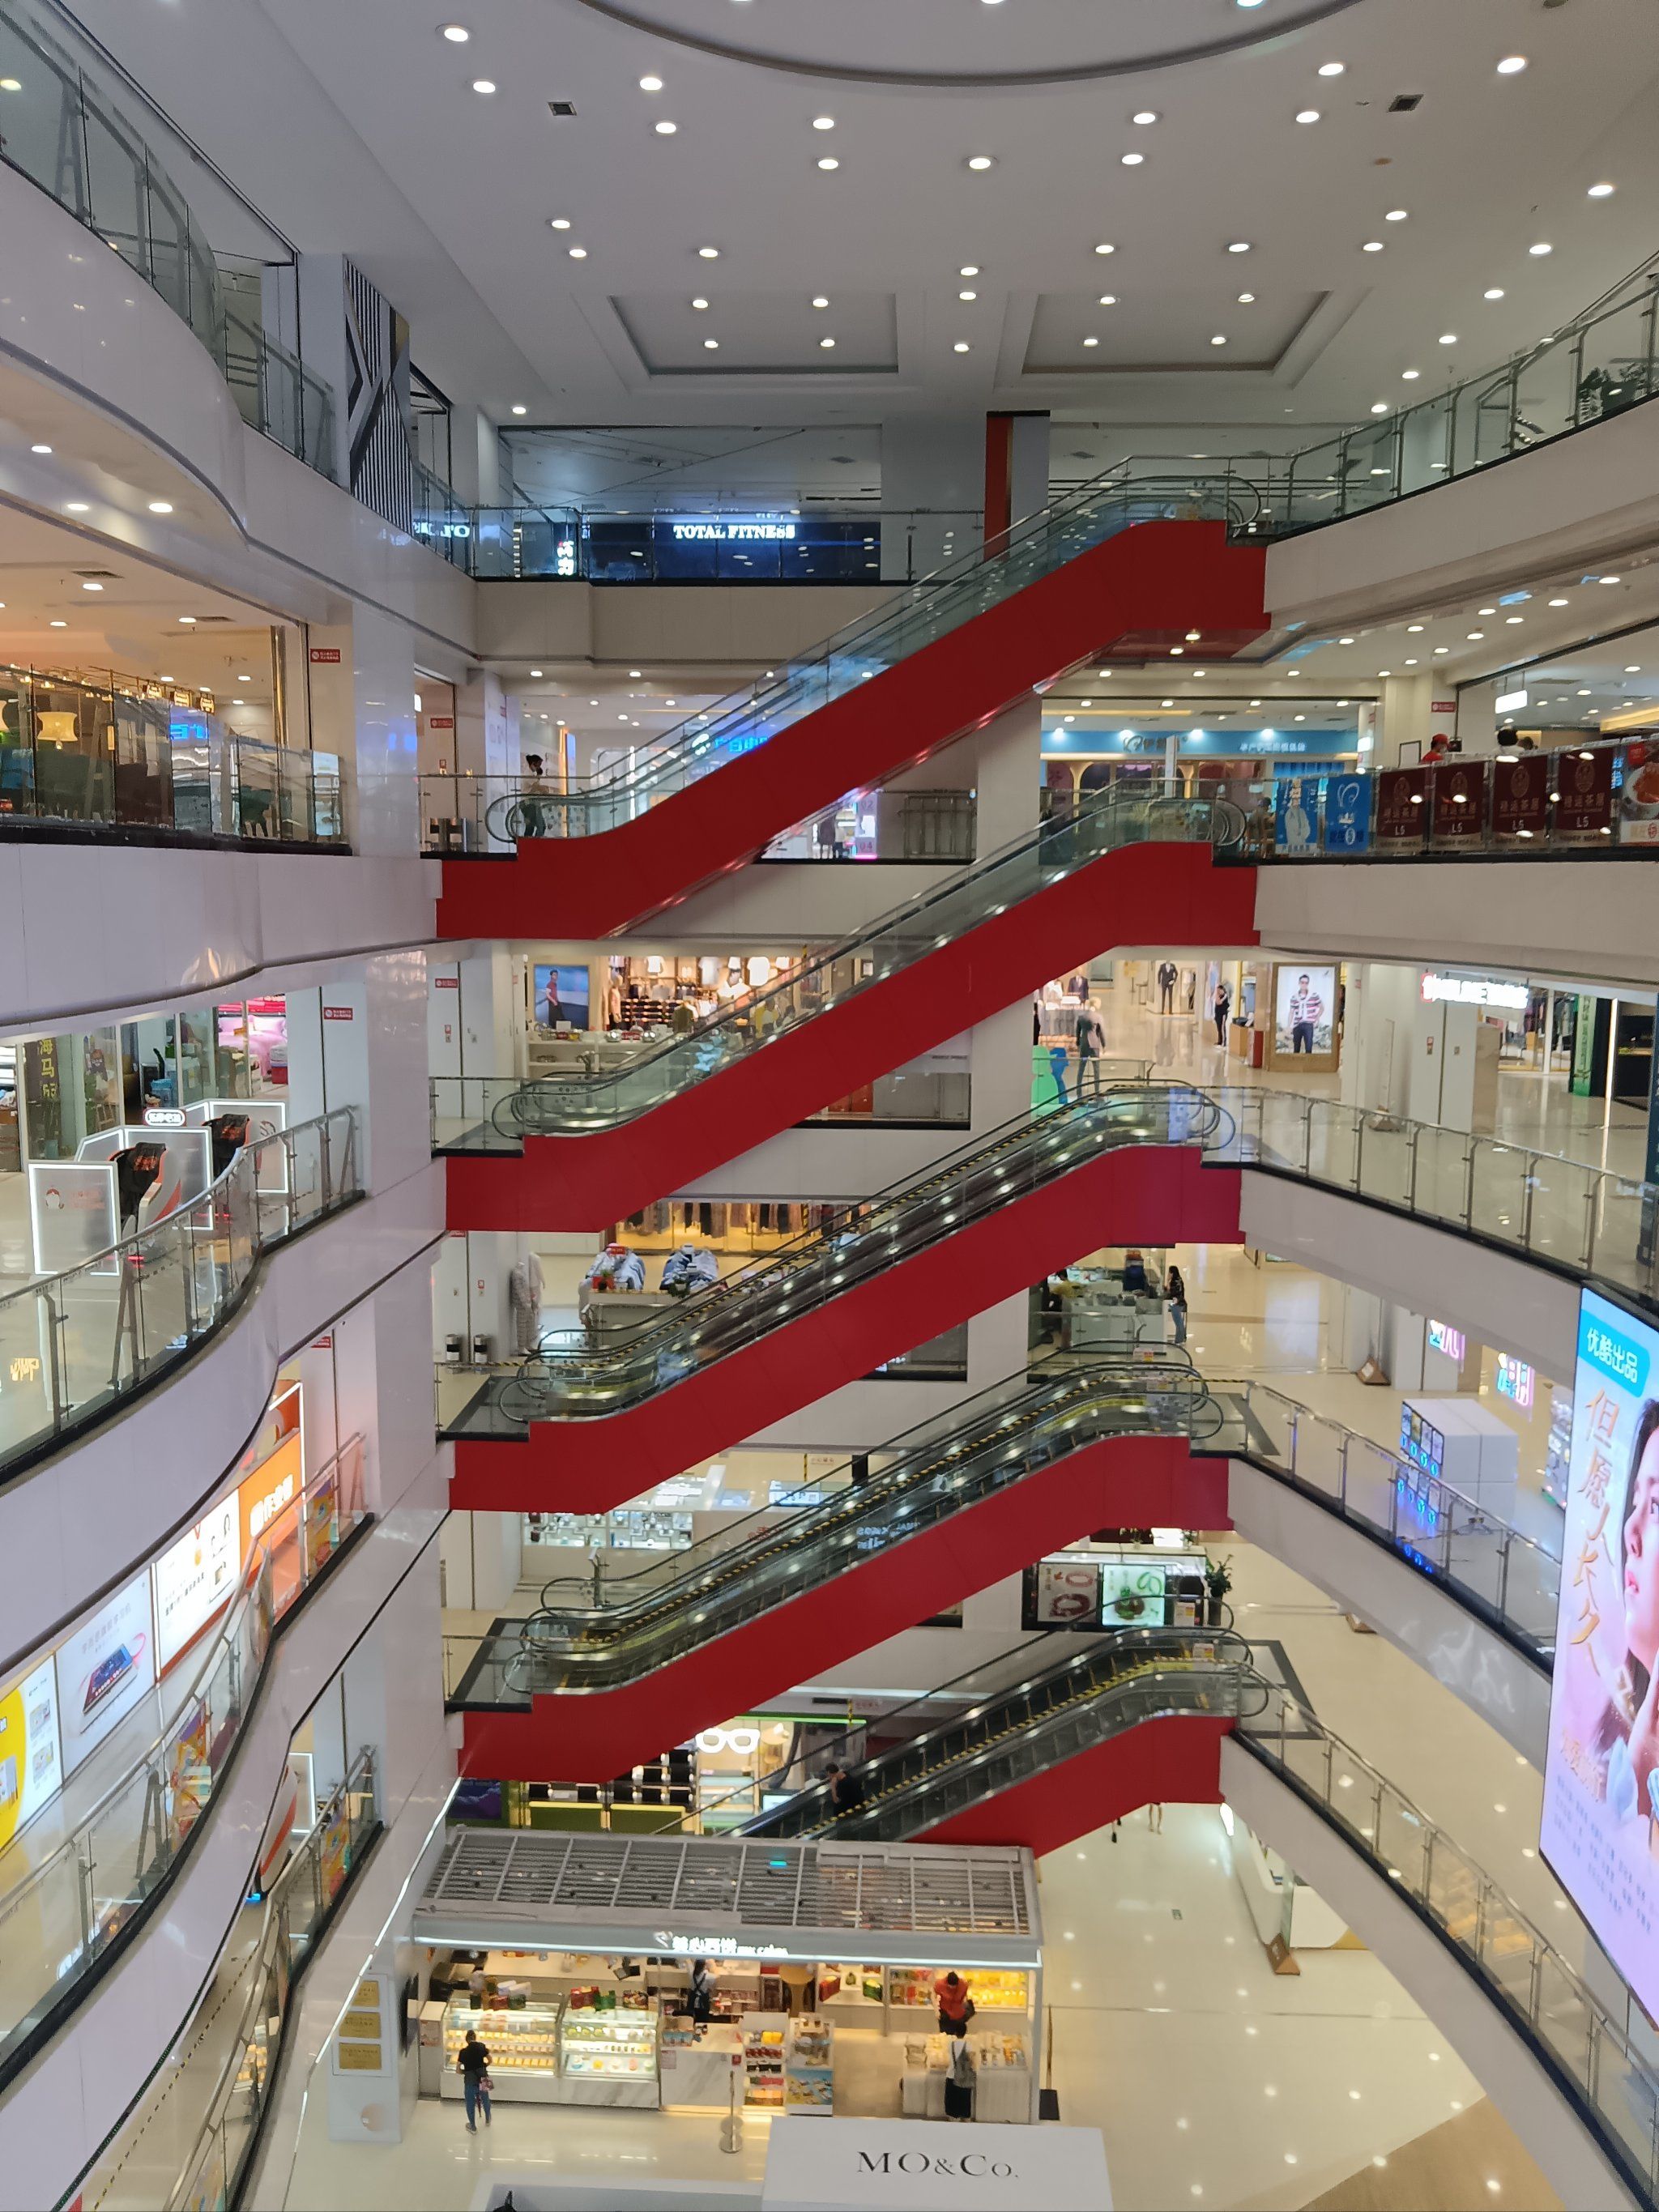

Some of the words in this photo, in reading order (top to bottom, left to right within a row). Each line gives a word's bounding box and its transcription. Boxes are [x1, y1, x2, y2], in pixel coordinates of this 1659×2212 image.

[673, 524, 726, 539] TOTAL
[727, 524, 796, 539] FITNESS
[1587, 1327, 1638, 1383] 优酷出品
[1570, 1387, 1619, 1677] 但愿人长久
[857, 2151, 1018, 2177] MO&Co.
